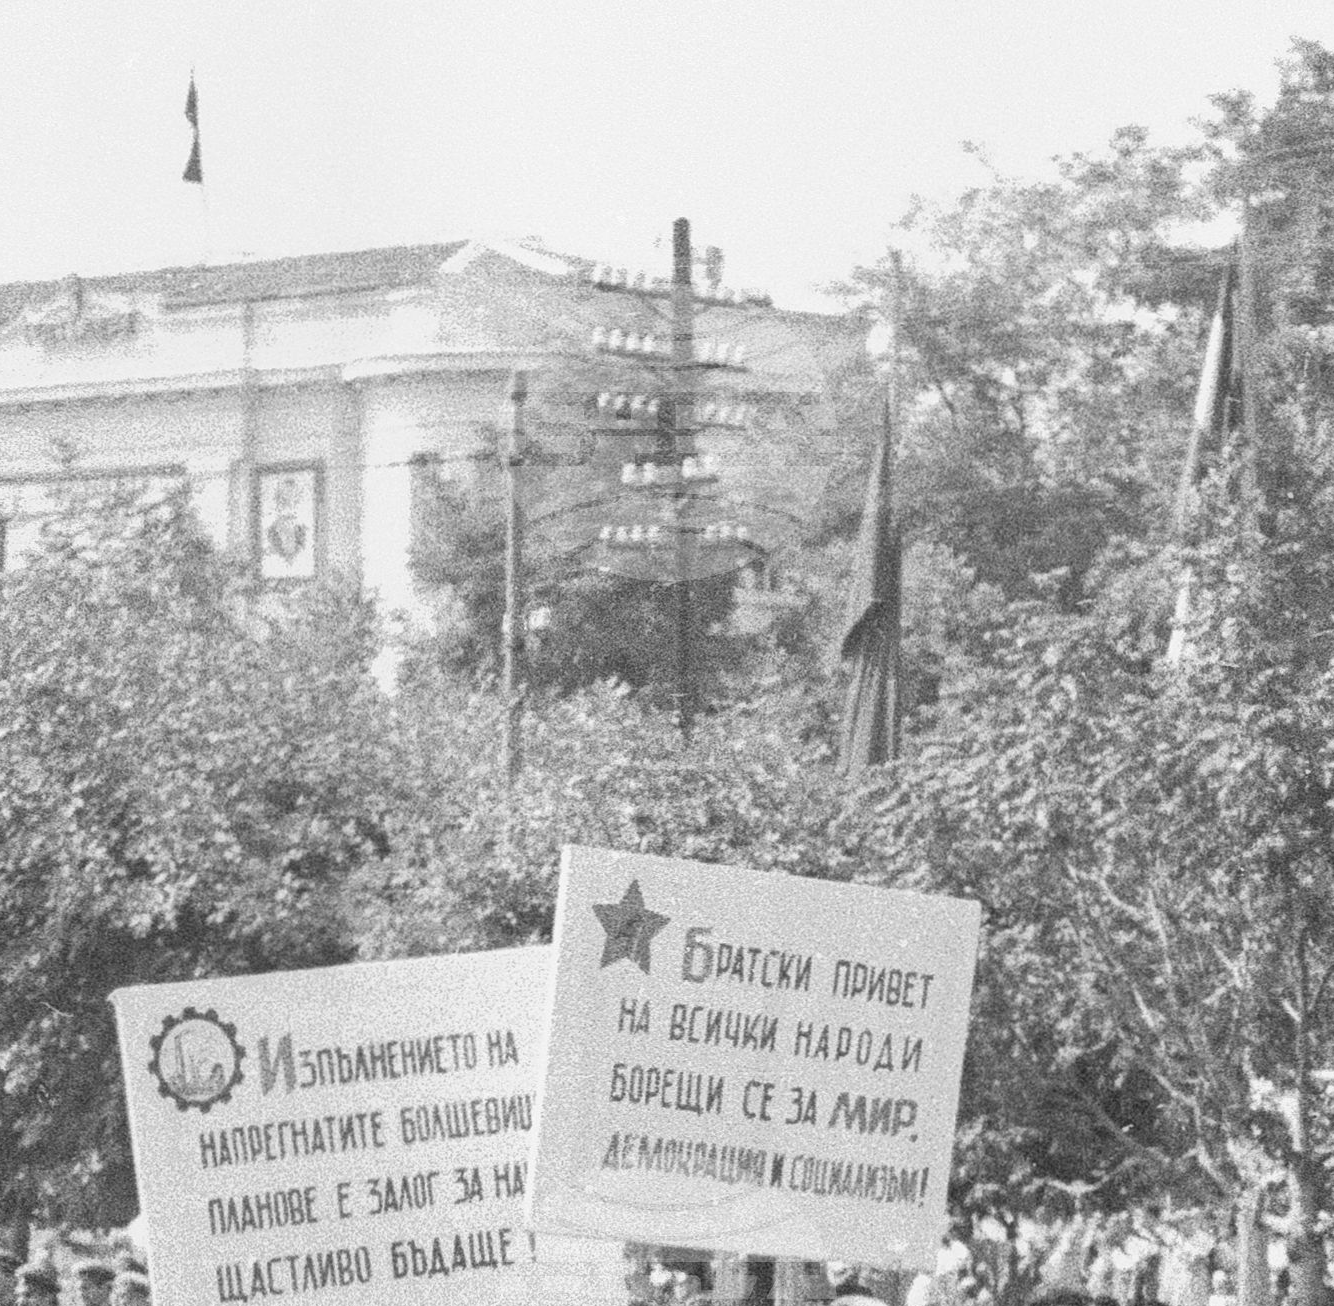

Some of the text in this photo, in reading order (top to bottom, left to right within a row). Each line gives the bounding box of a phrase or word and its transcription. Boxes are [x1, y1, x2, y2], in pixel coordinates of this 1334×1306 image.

[682, 926, 934, 1009] БРАТСКИ ПРИВЕТ
[257, 1029, 520, 1097] ИЗПЪЛНЕНИЕТО НА
[618, 998, 923, 1073] НА ВСИЧКИ НАРОДИ
[609, 1062, 724, 1117] БОРЕЩИ
[742, 1079, 775, 1122] СЕ
[785, 1086, 818, 1126] ЗА
[199, 1110, 386, 1169] НАПРЕГНАТИТЕ
[602, 1130, 768, 1189] ДЕМОКРАЦИЯ
[769, 1152, 786, 1189] И
[207, 1185, 318, 1235] ПЛАНОВЕ
[336, 1181, 353, 1219] Е
[367, 1170, 441, 1216] ЗАЛОГ
[453, 1167, 484, 1205] ЗА
[216, 1245, 372, 1304] ЩАСТЛИВО
